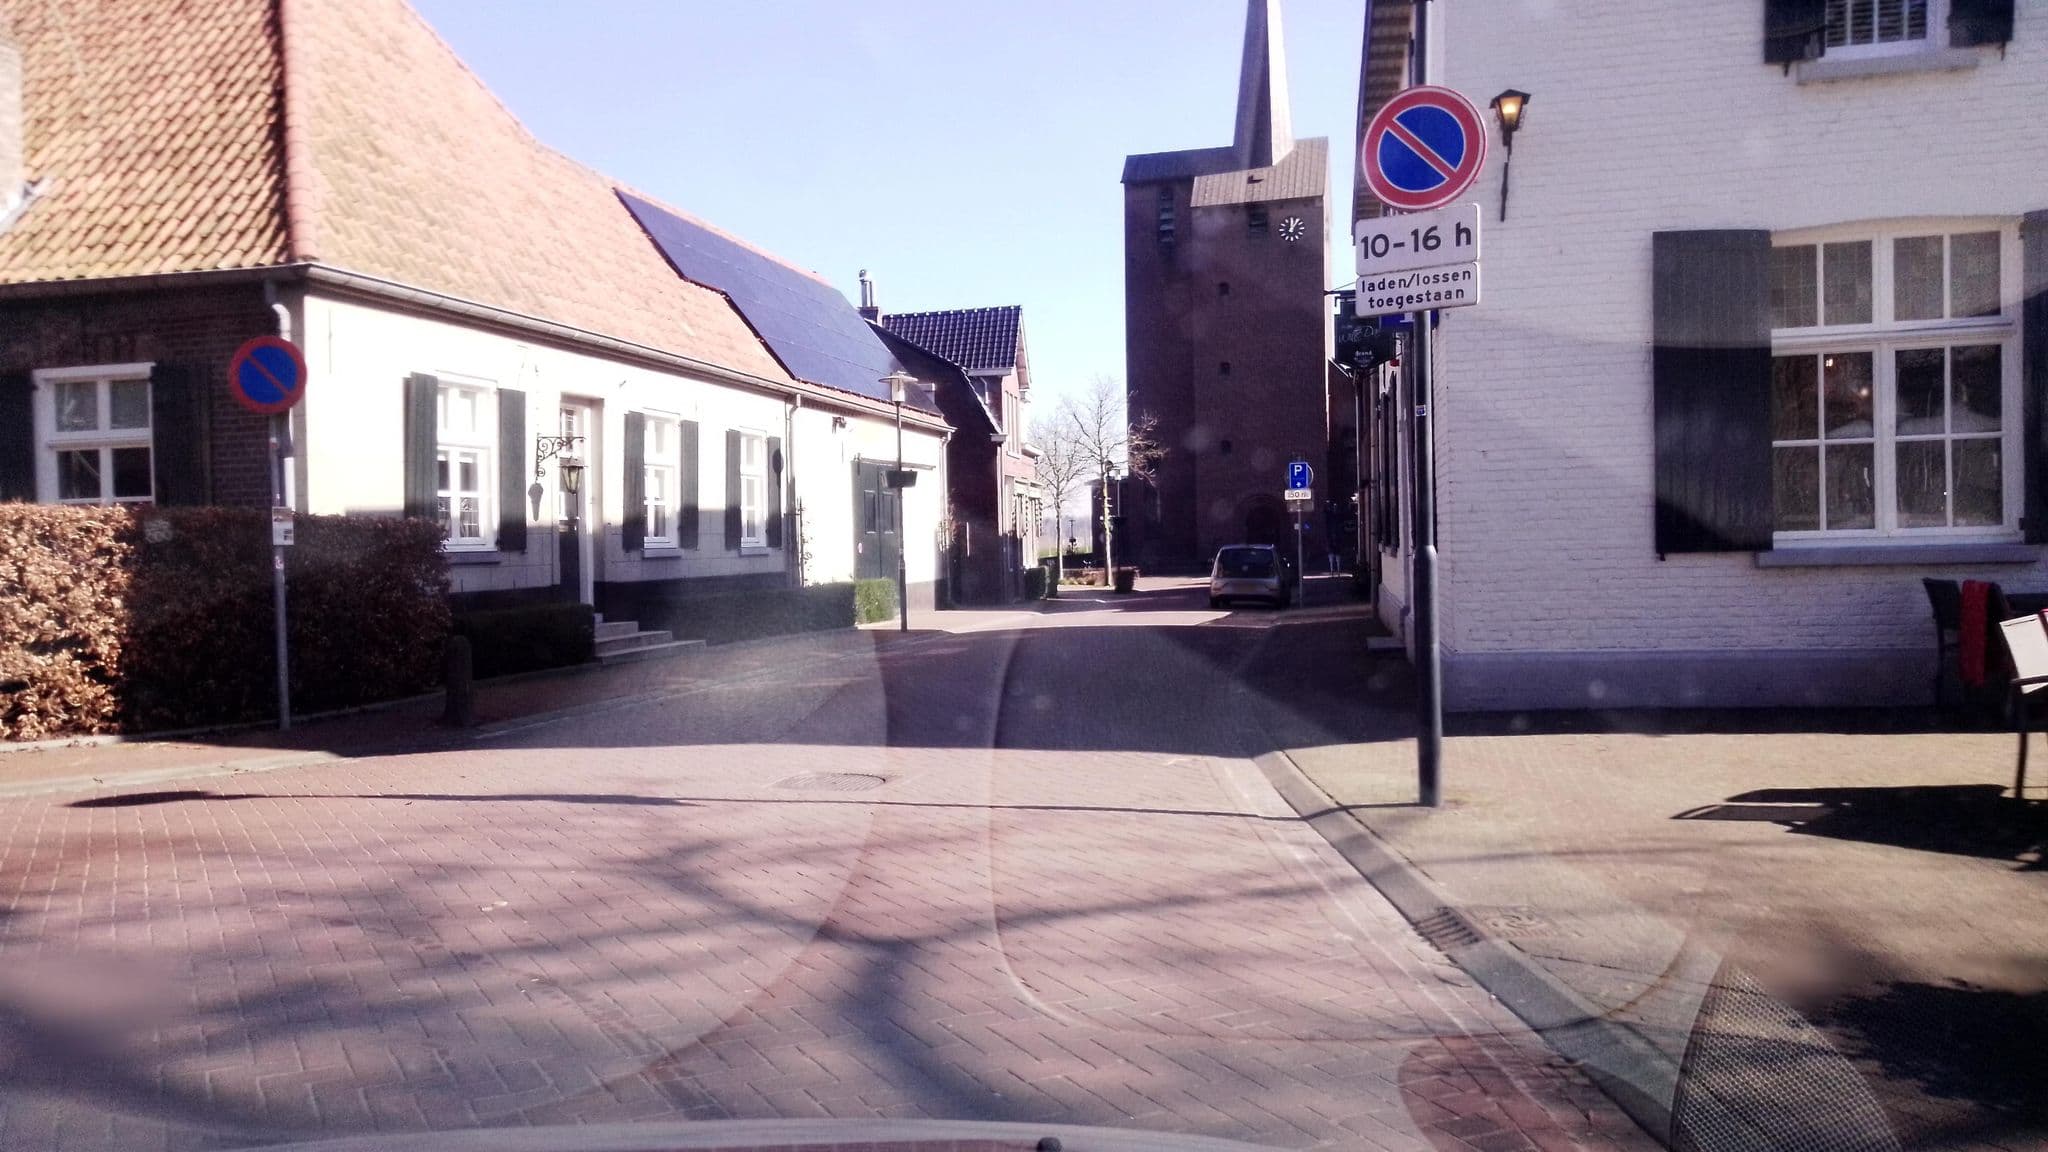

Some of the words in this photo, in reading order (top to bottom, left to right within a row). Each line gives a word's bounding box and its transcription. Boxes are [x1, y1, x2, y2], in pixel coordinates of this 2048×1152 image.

[1360, 225, 1441, 260] 10-16
[1455, 221, 1472, 247] h
[1361, 270, 1471, 293] laden/lossen
[1368, 288, 1465, 309] toegestaan
[1294, 464, 1303, 476] P
